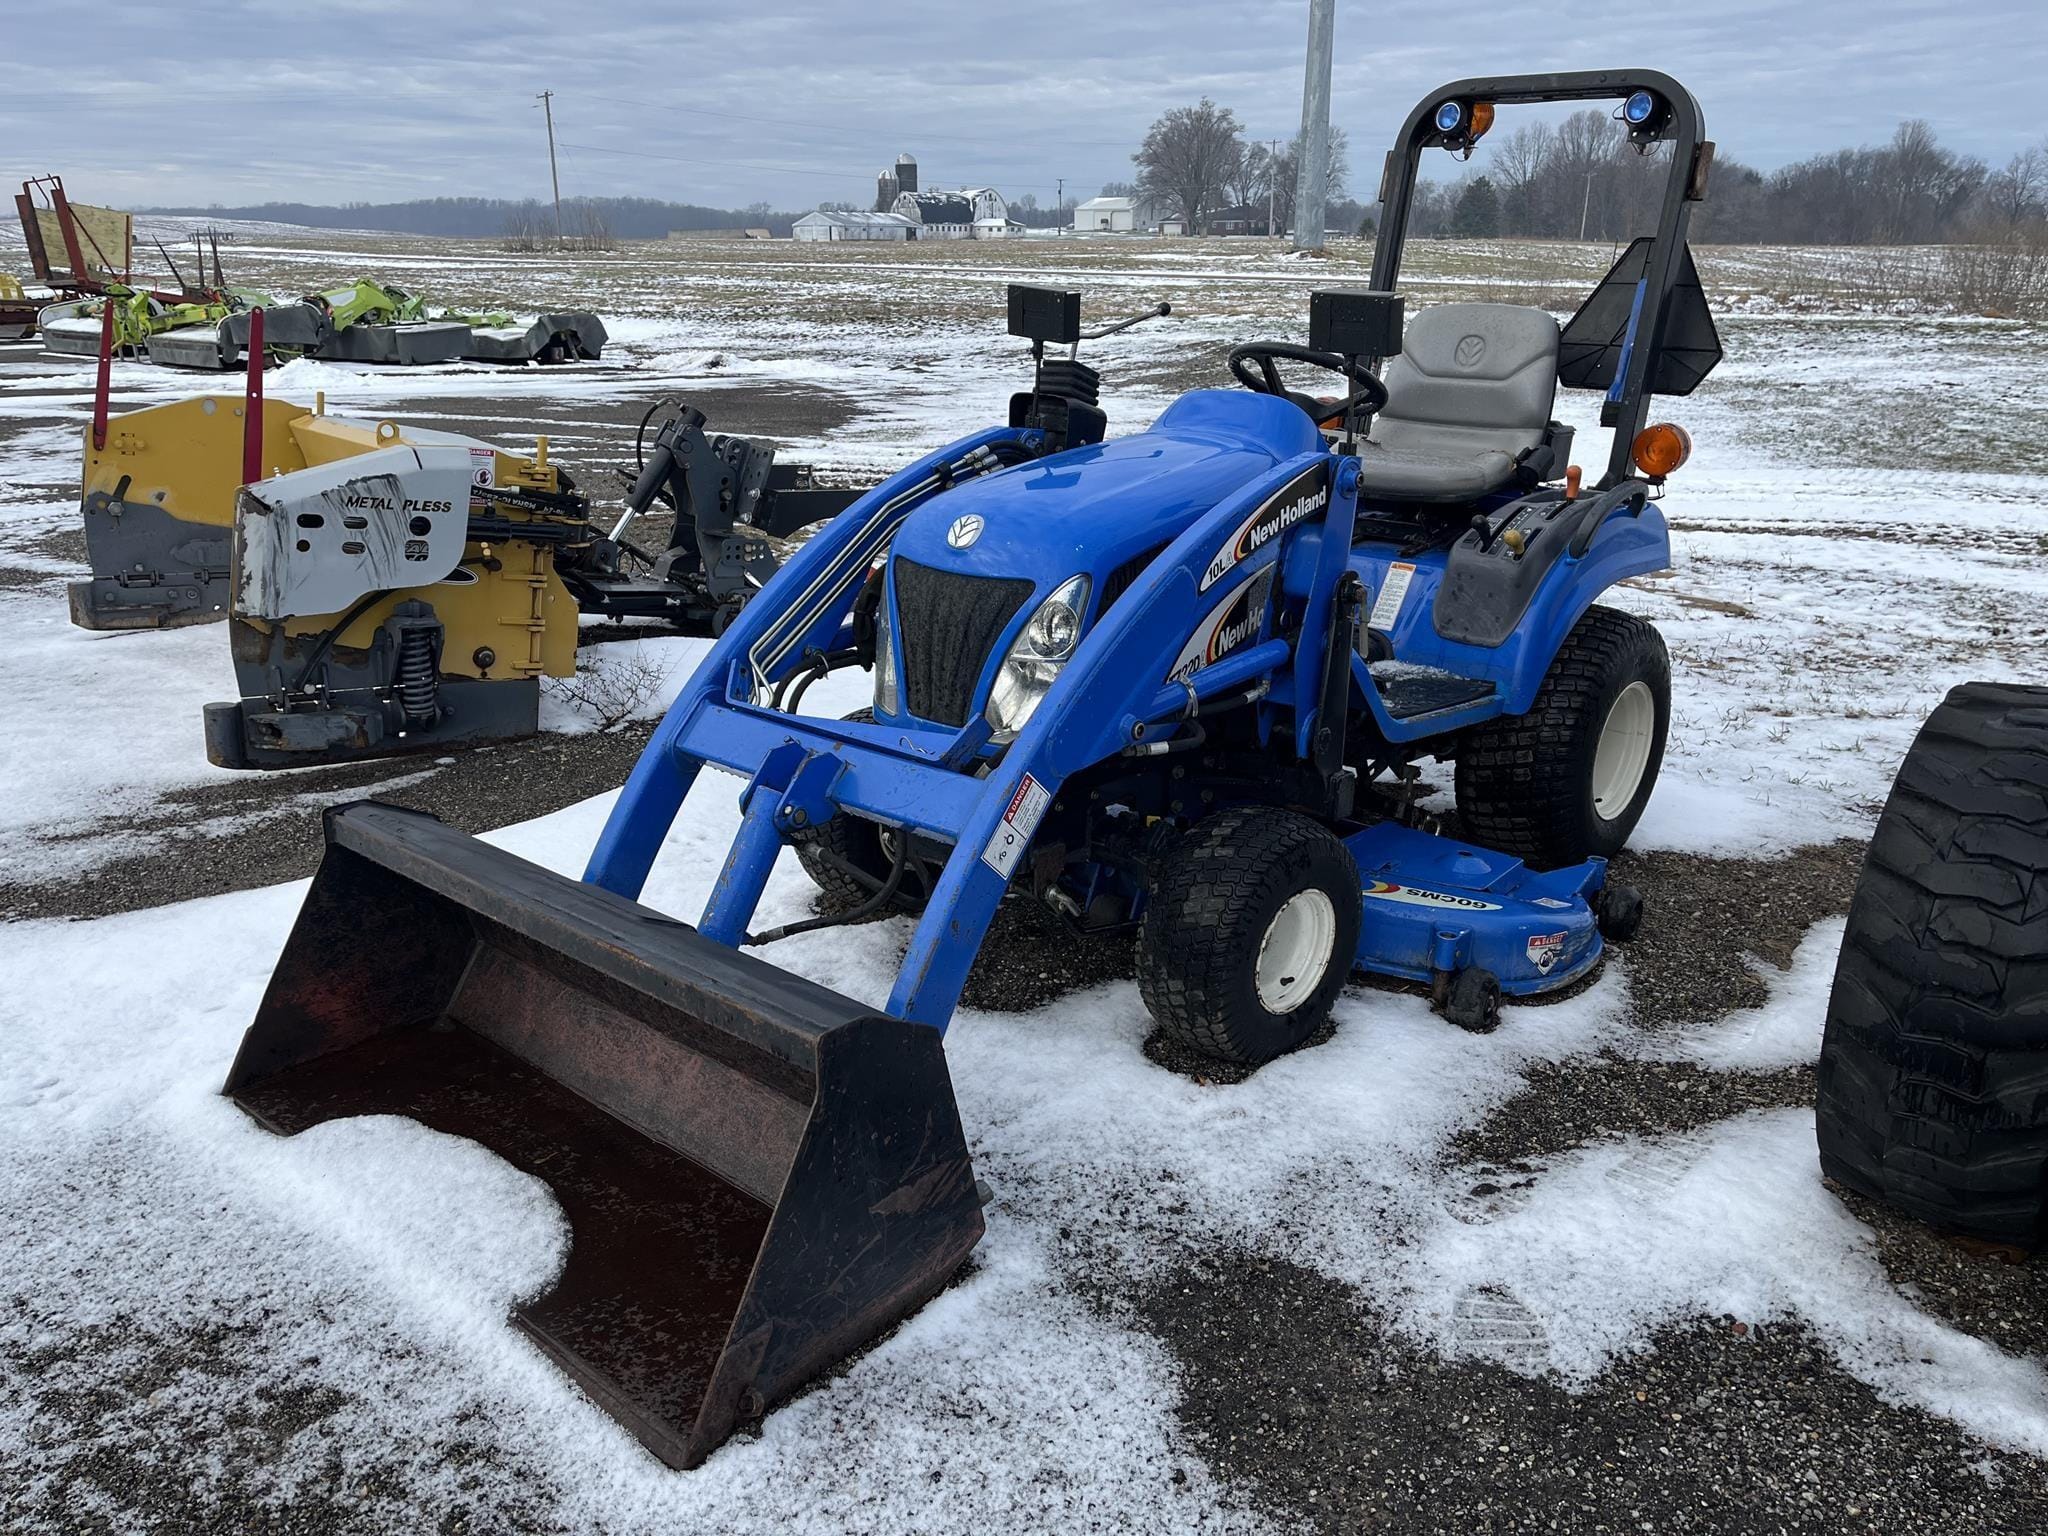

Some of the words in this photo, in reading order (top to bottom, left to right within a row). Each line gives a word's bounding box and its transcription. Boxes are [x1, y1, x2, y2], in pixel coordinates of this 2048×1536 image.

[345, 495, 394, 510] METAL
[402, 499, 452, 513] PLESS
[1250, 517, 1280, 550] New
[1280, 485, 1327, 529] Holland
[1218, 617, 1248, 657] New
[1011, 779, 1031, 812] DANGER
[1406, 888, 1487, 909] 60CMS
